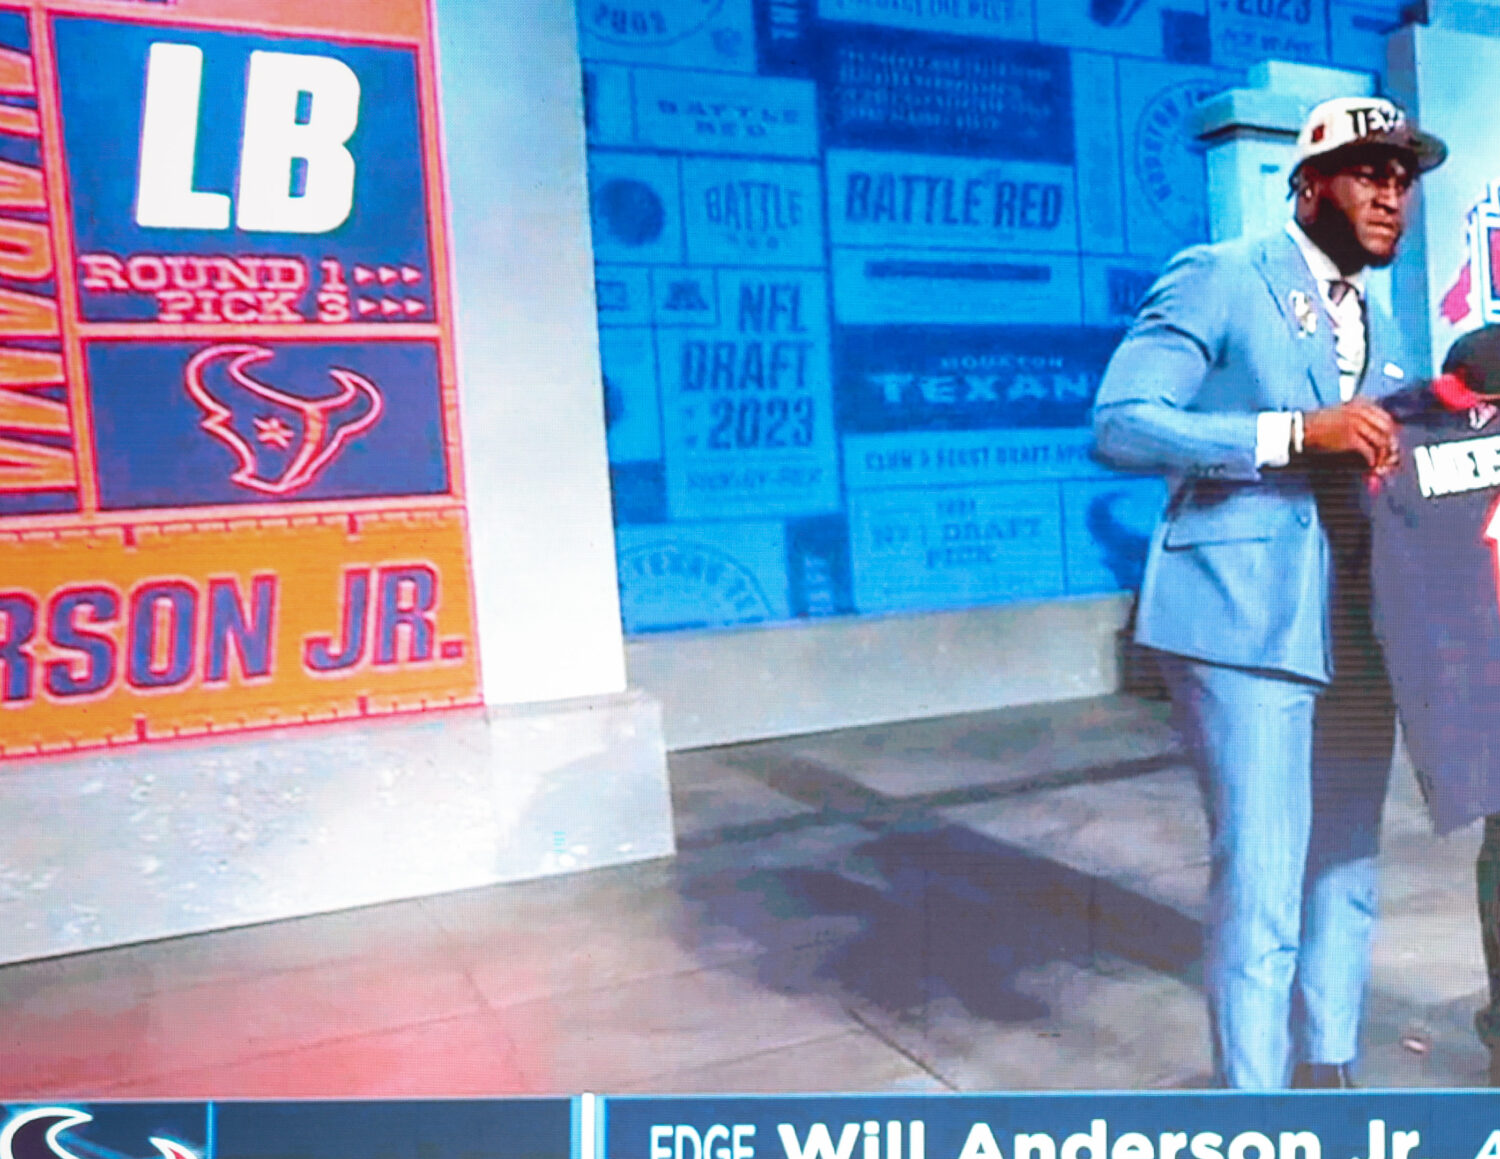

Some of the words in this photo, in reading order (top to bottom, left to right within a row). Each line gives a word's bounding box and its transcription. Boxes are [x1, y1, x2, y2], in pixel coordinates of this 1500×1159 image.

[136, 42, 361, 233] LB
[705, 179, 802, 233] BATTLE
[847, 172, 988, 225] BATTLE
[993, 181, 1063, 231] RED
[81, 254, 304, 291] ROUND
[319, 261, 345, 291] 1
[158, 290, 301, 322] PICK
[317, 292, 349, 322] 3
[738, 283, 807, 333] NFL
[682, 339, 815, 391] DRAFT
[867, 373, 1099, 403] TEXAN
[707, 397, 814, 449] 2023
[304, 563, 465, 674] JR.
